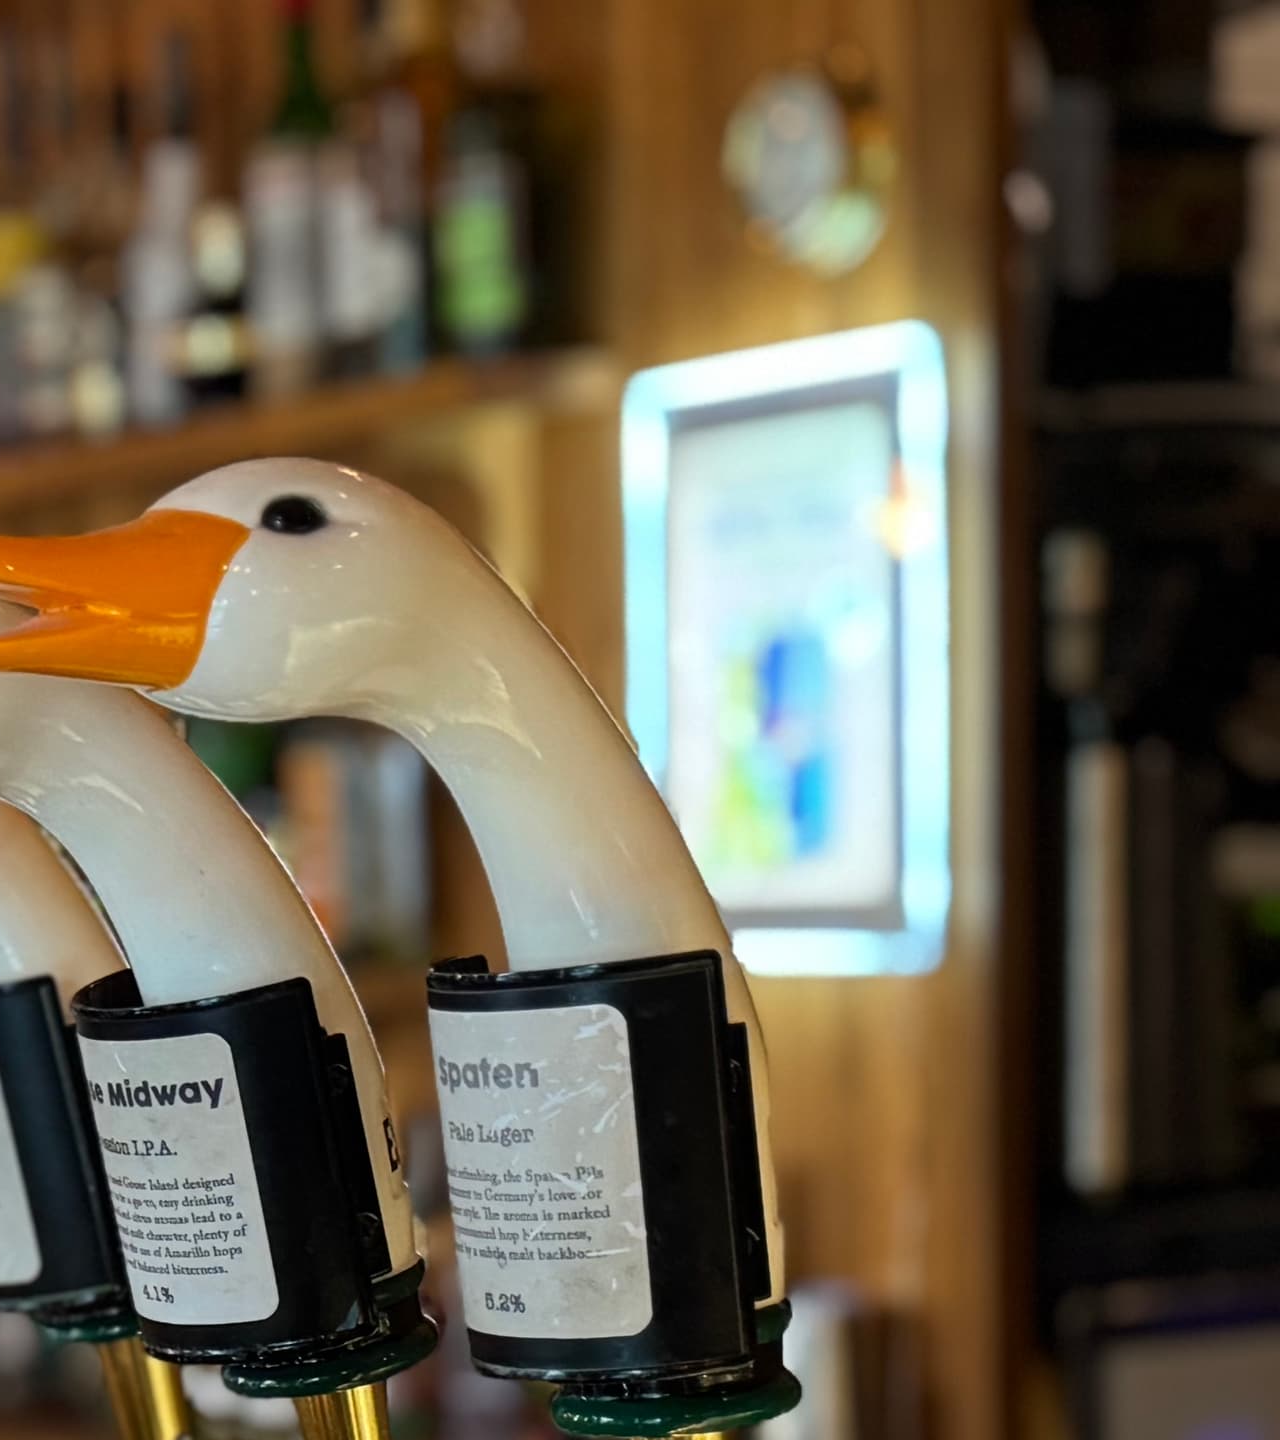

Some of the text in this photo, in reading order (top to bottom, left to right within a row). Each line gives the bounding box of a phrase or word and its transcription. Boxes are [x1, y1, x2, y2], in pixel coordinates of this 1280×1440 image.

[438, 1055, 539, 1094] Spaten
[107, 1077, 224, 1109] Midway
[448, 1121, 474, 1142] Pale
[131, 1139, 178, 1156] I.P.A.
[183, 1173, 235, 1192] designed
[525, 1167, 571, 1187] Span
[182, 1194, 234, 1207] drinking
[484, 1187, 544, 1207] Germany's
[548, 1188, 577, 1201] love
[582, 1189, 603, 1200] or
[191, 1211, 215, 1223] lead
[220, 1212, 232, 1221] to
[236, 1212, 243, 1220] a
[558, 1204, 611, 1221] marked
[194, 1229, 229, 1243] plenty
[233, 1224, 248, 1237] of
[213, 1246, 243, 1259] hops
